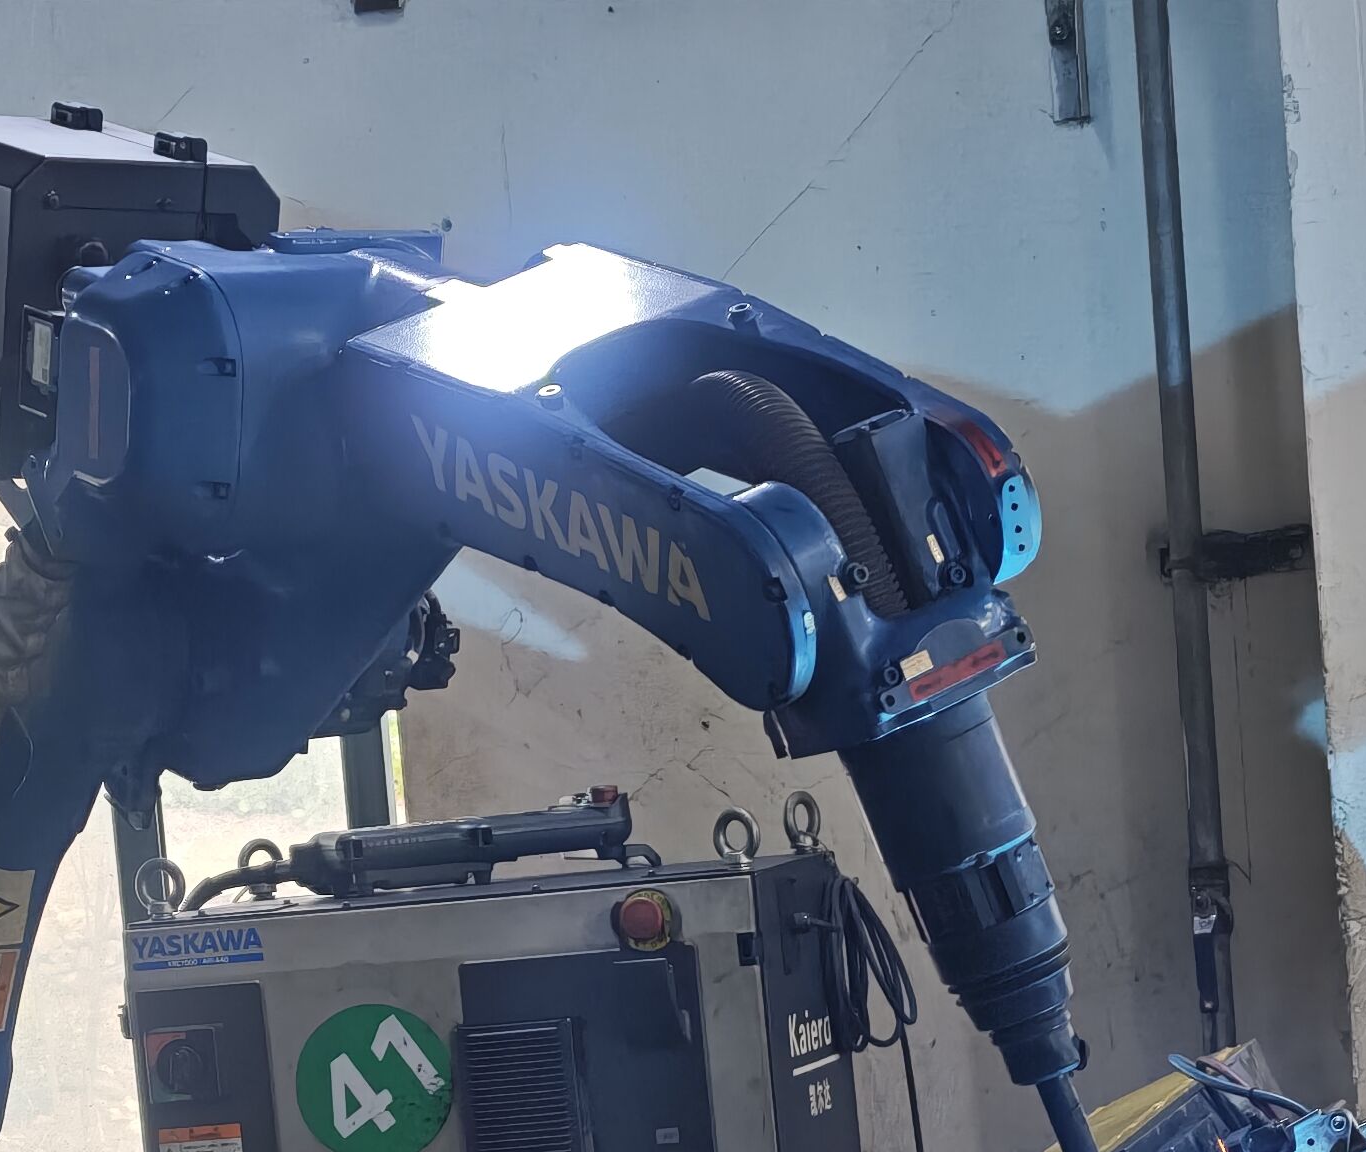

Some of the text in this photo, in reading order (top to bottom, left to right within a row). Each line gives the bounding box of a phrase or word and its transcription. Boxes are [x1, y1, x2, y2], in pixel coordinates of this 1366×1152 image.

[410, 413, 712, 622] YASKAWA
[131, 927, 263, 960] YASKAWA
[330, 1013, 446, 1139] 41
